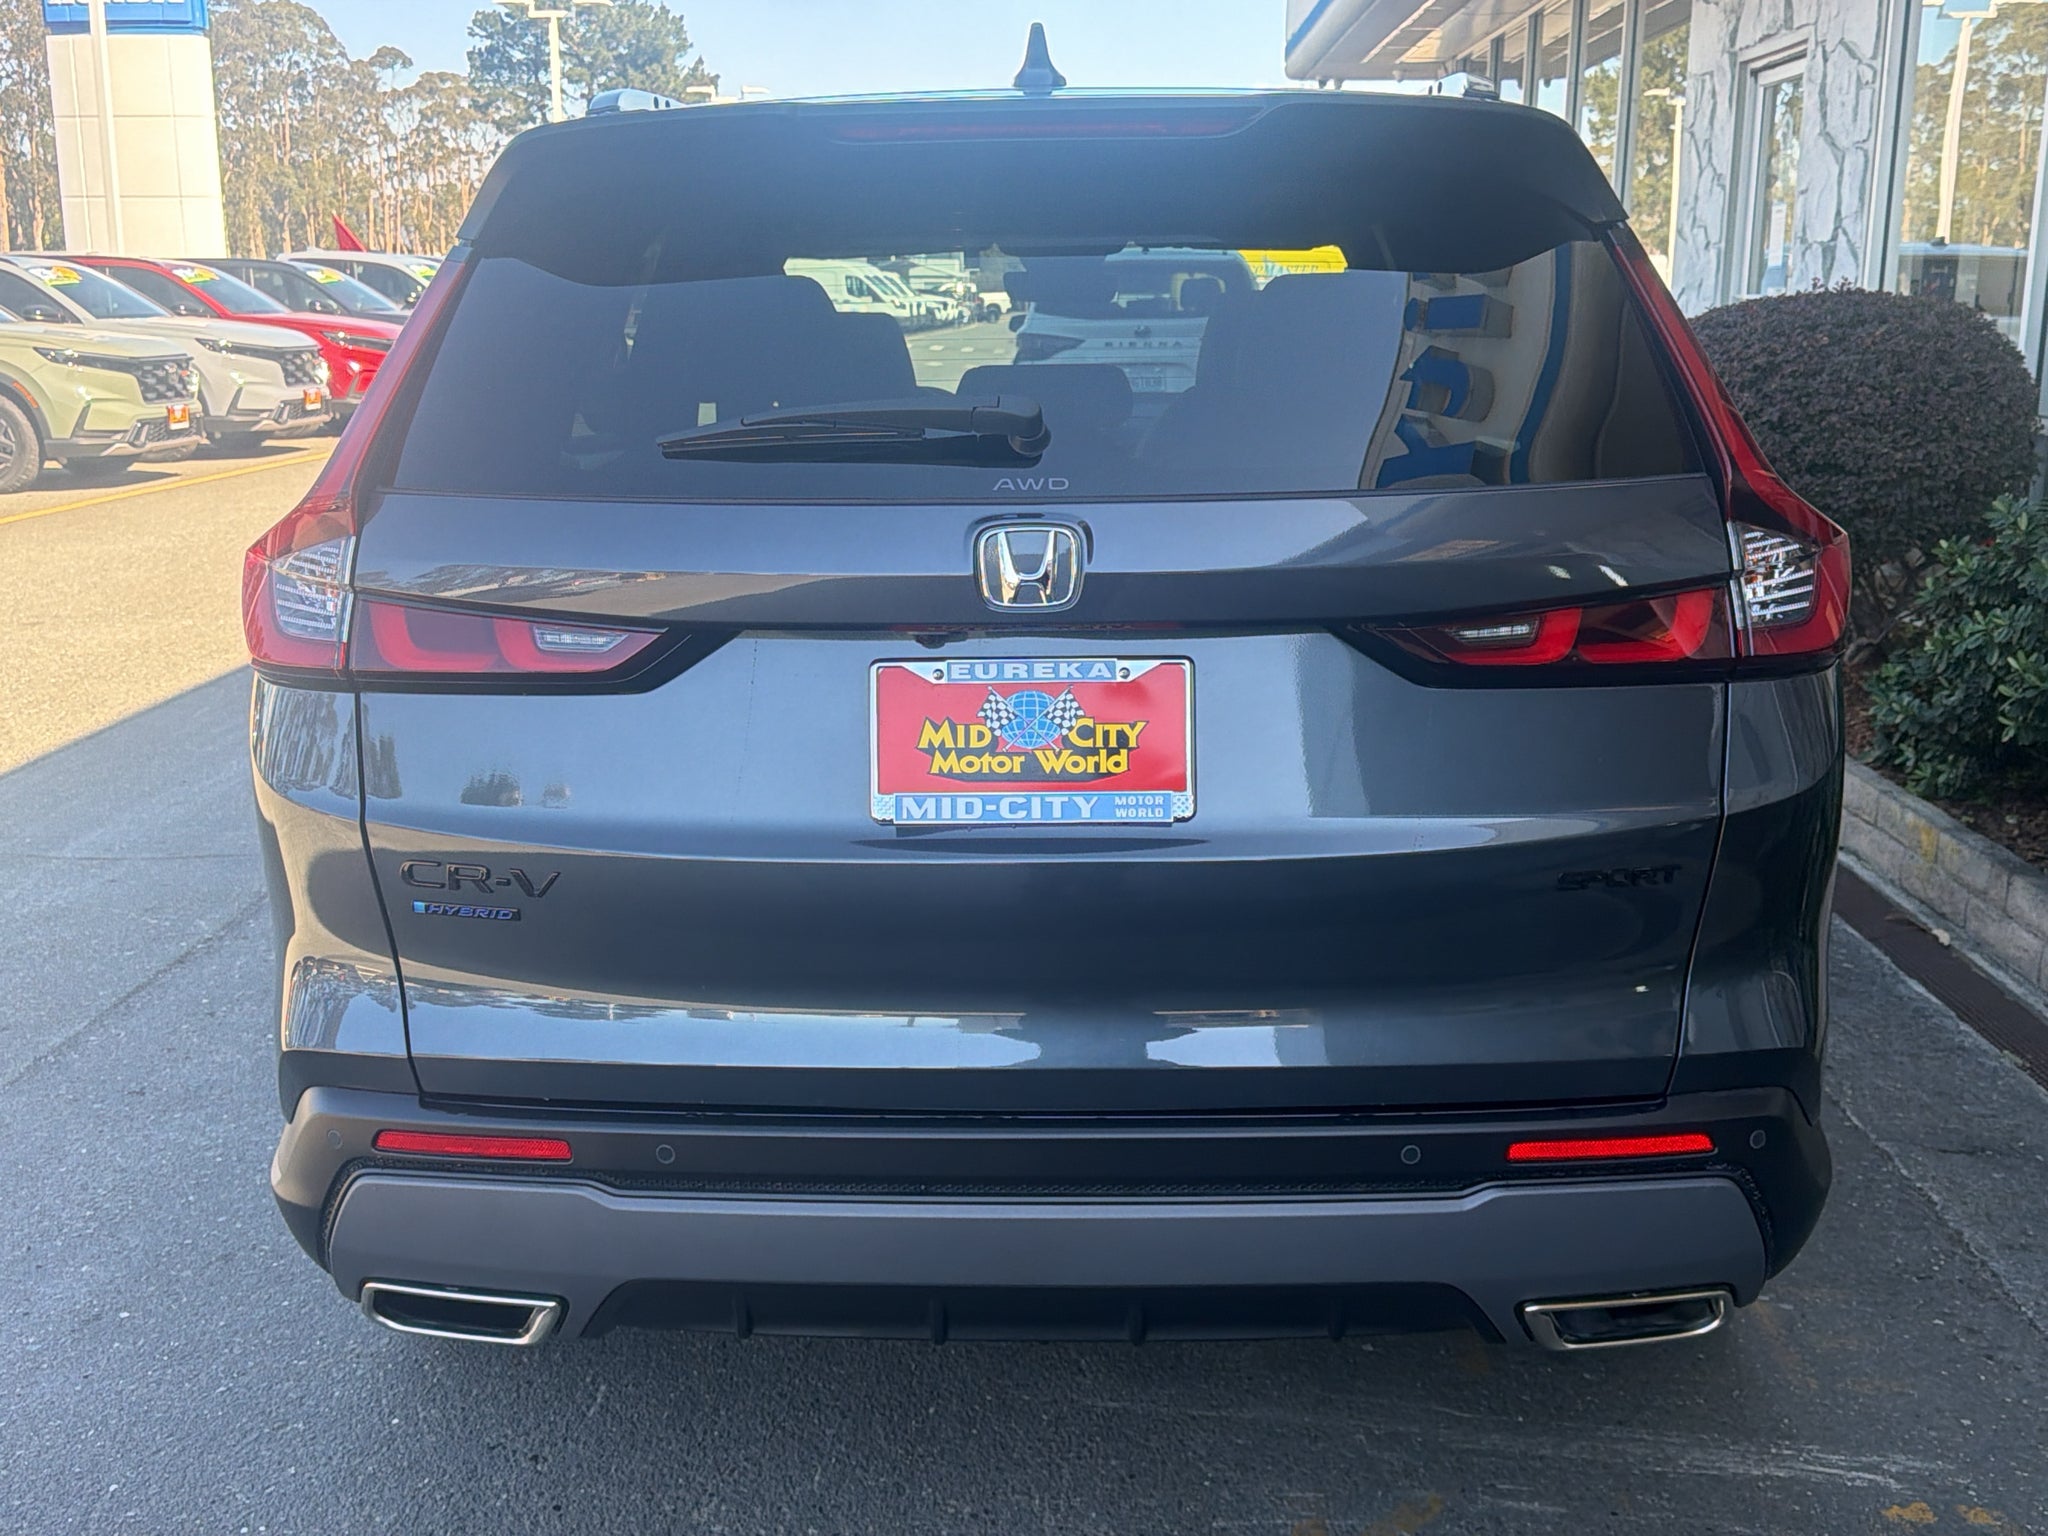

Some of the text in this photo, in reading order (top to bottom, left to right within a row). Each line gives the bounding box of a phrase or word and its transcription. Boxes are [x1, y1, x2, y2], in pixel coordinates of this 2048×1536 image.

[992, 477, 1069, 491] AWD
[950, 662, 1113, 680] EUREKA
[929, 750, 1129, 774] Motor World
[902, 796, 1098, 819] MID-CITY
[1114, 796, 1164, 806] MOTOR
[1114, 808, 1164, 818] WORLD
[400, 859, 562, 898] CR-V
[1557, 864, 1682, 891] SPORT
[427, 903, 514, 920] HYBRID
